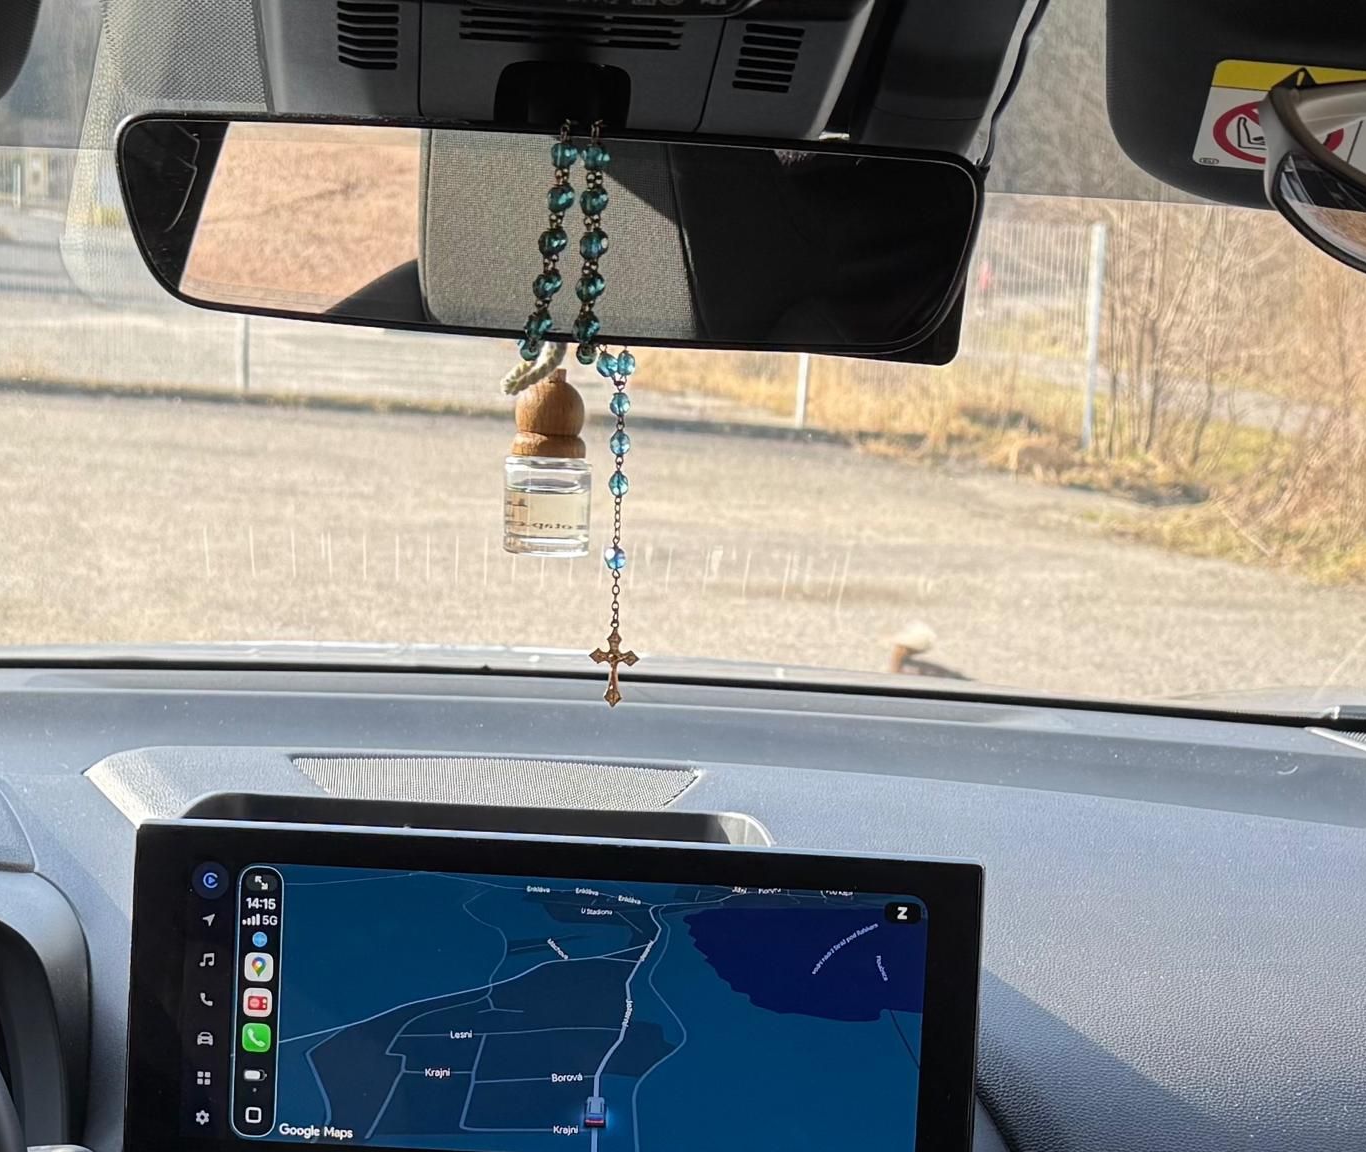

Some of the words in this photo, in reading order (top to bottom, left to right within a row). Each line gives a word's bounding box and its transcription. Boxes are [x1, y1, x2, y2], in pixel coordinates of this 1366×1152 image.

[246, 898, 276, 910] 14:15
[897, 907, 908, 920] Z
[262, 915, 278, 926] 5G
[551, 1073, 583, 1082] Borová
[279, 1123, 320, 1139] Google
[324, 1127, 353, 1140] Maps
